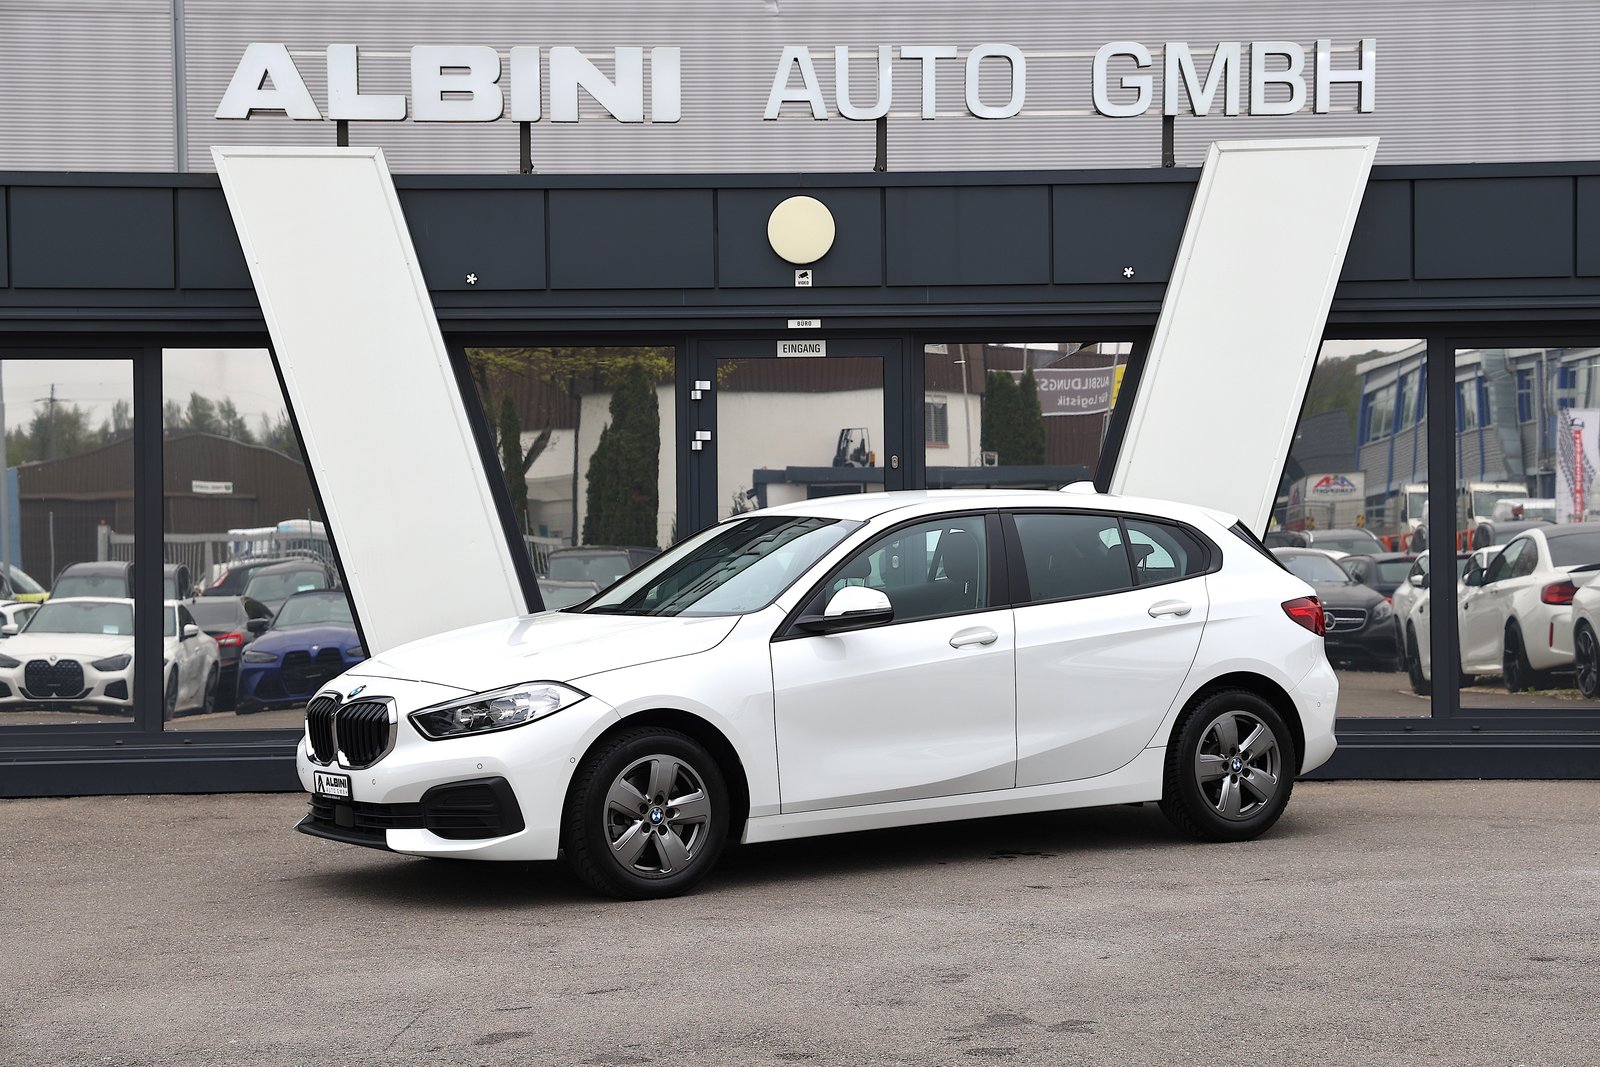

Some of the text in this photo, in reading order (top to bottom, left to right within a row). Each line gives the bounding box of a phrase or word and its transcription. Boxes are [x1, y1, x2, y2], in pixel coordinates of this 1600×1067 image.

[215, 38, 1377, 123] ALBINI AUTO GMBH
[796, 319, 813, 327] BÜRO
[782, 343, 821, 354] EINGANG
[325, 776, 347, 789] ALBINI
